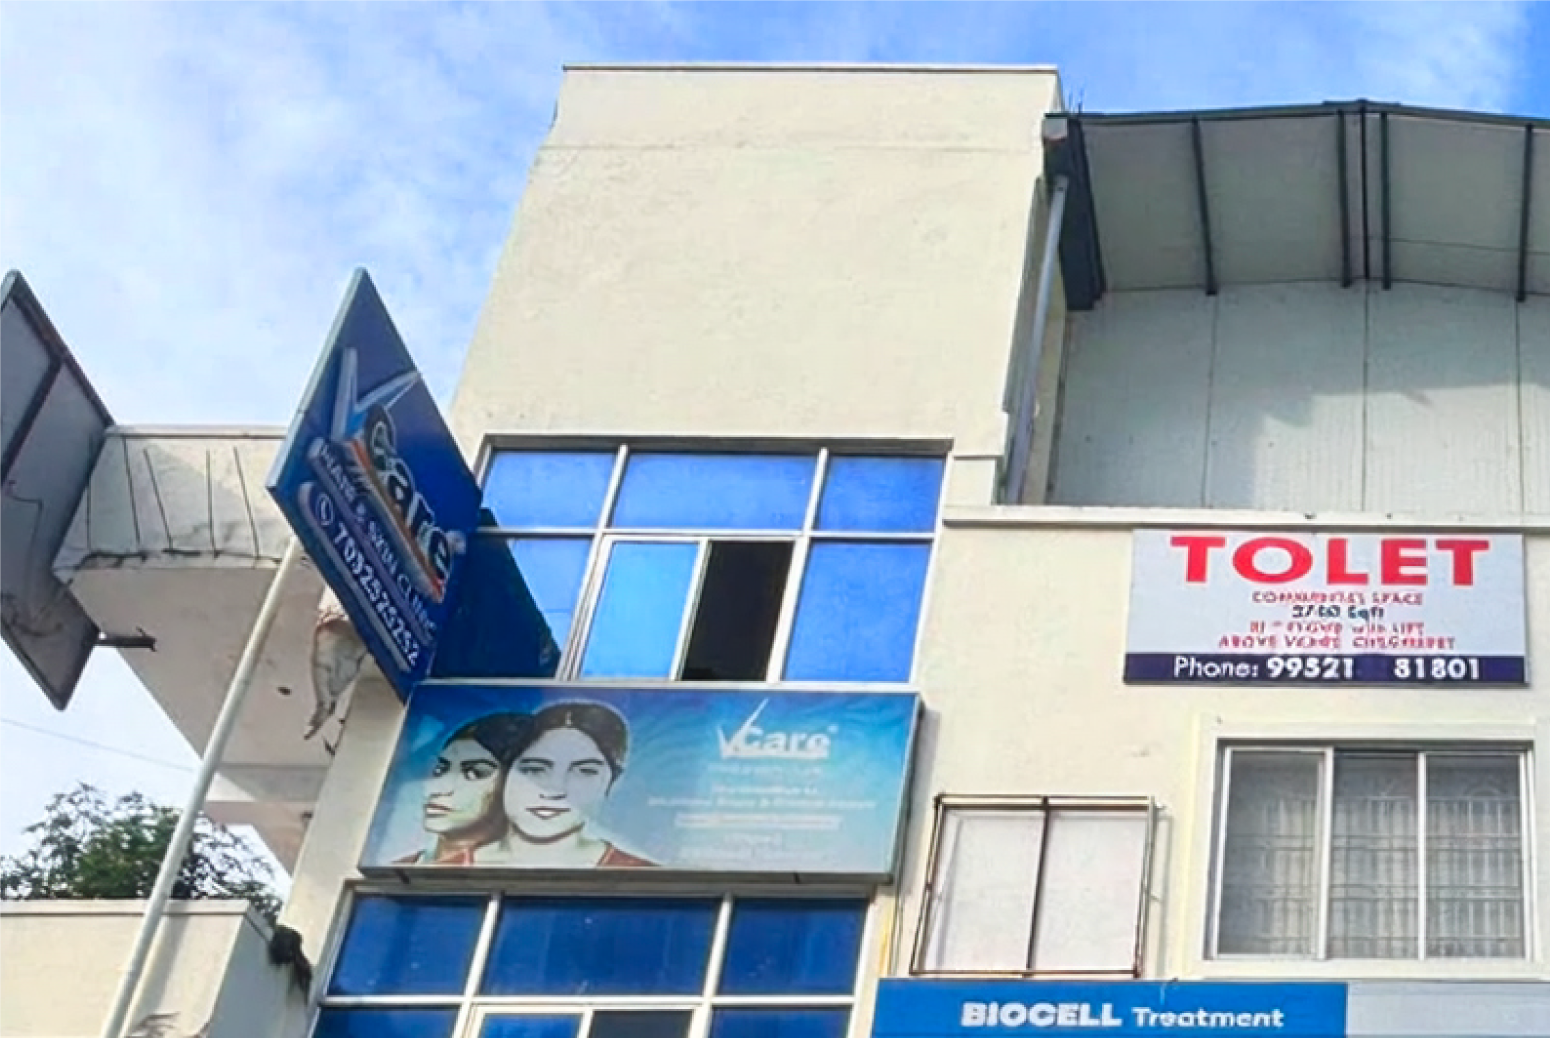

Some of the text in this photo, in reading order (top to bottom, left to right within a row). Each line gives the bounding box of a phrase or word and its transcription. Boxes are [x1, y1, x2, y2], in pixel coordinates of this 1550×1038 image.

[1170, 536, 1490, 586] TOLET
[1174, 656, 1480, 679] Phone: 99521 81801
[961, 1003, 1285, 1029] BIOCELL Treatment
